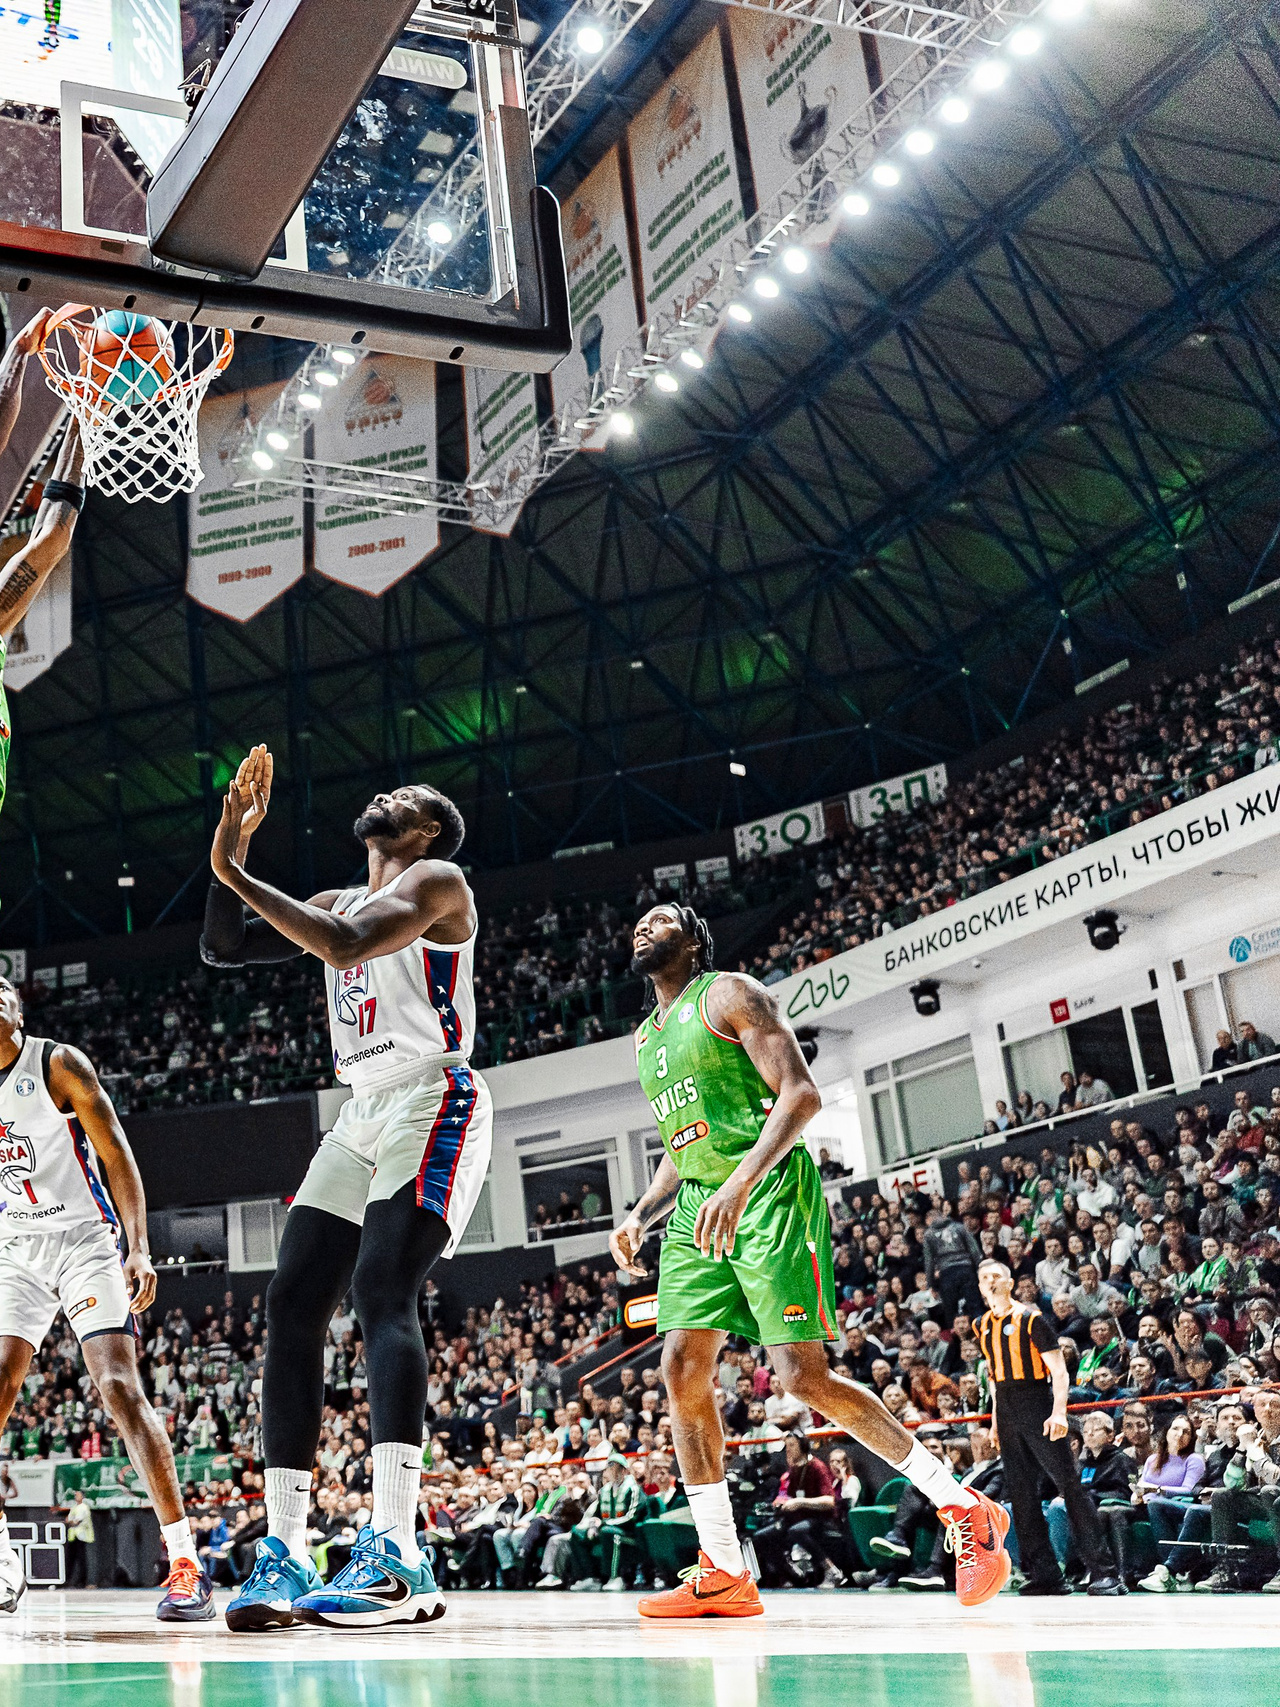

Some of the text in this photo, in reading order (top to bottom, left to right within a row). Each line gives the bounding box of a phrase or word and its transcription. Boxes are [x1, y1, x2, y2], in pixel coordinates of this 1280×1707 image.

[884, 894, 1029, 972] БАНКОВСКИЕ
[1034, 855, 1127, 910] КАРТЫ,
[1132, 808, 1230, 864] ЧТОБЫ
[358, 997, 377, 1038] 17
[338, 1040, 396, 1068] Ростелеком
[655, 1045, 668, 1079] 3
[22, 1178, 39, 1205] 1
[6, 1203, 66, 1221] Ростлеком
